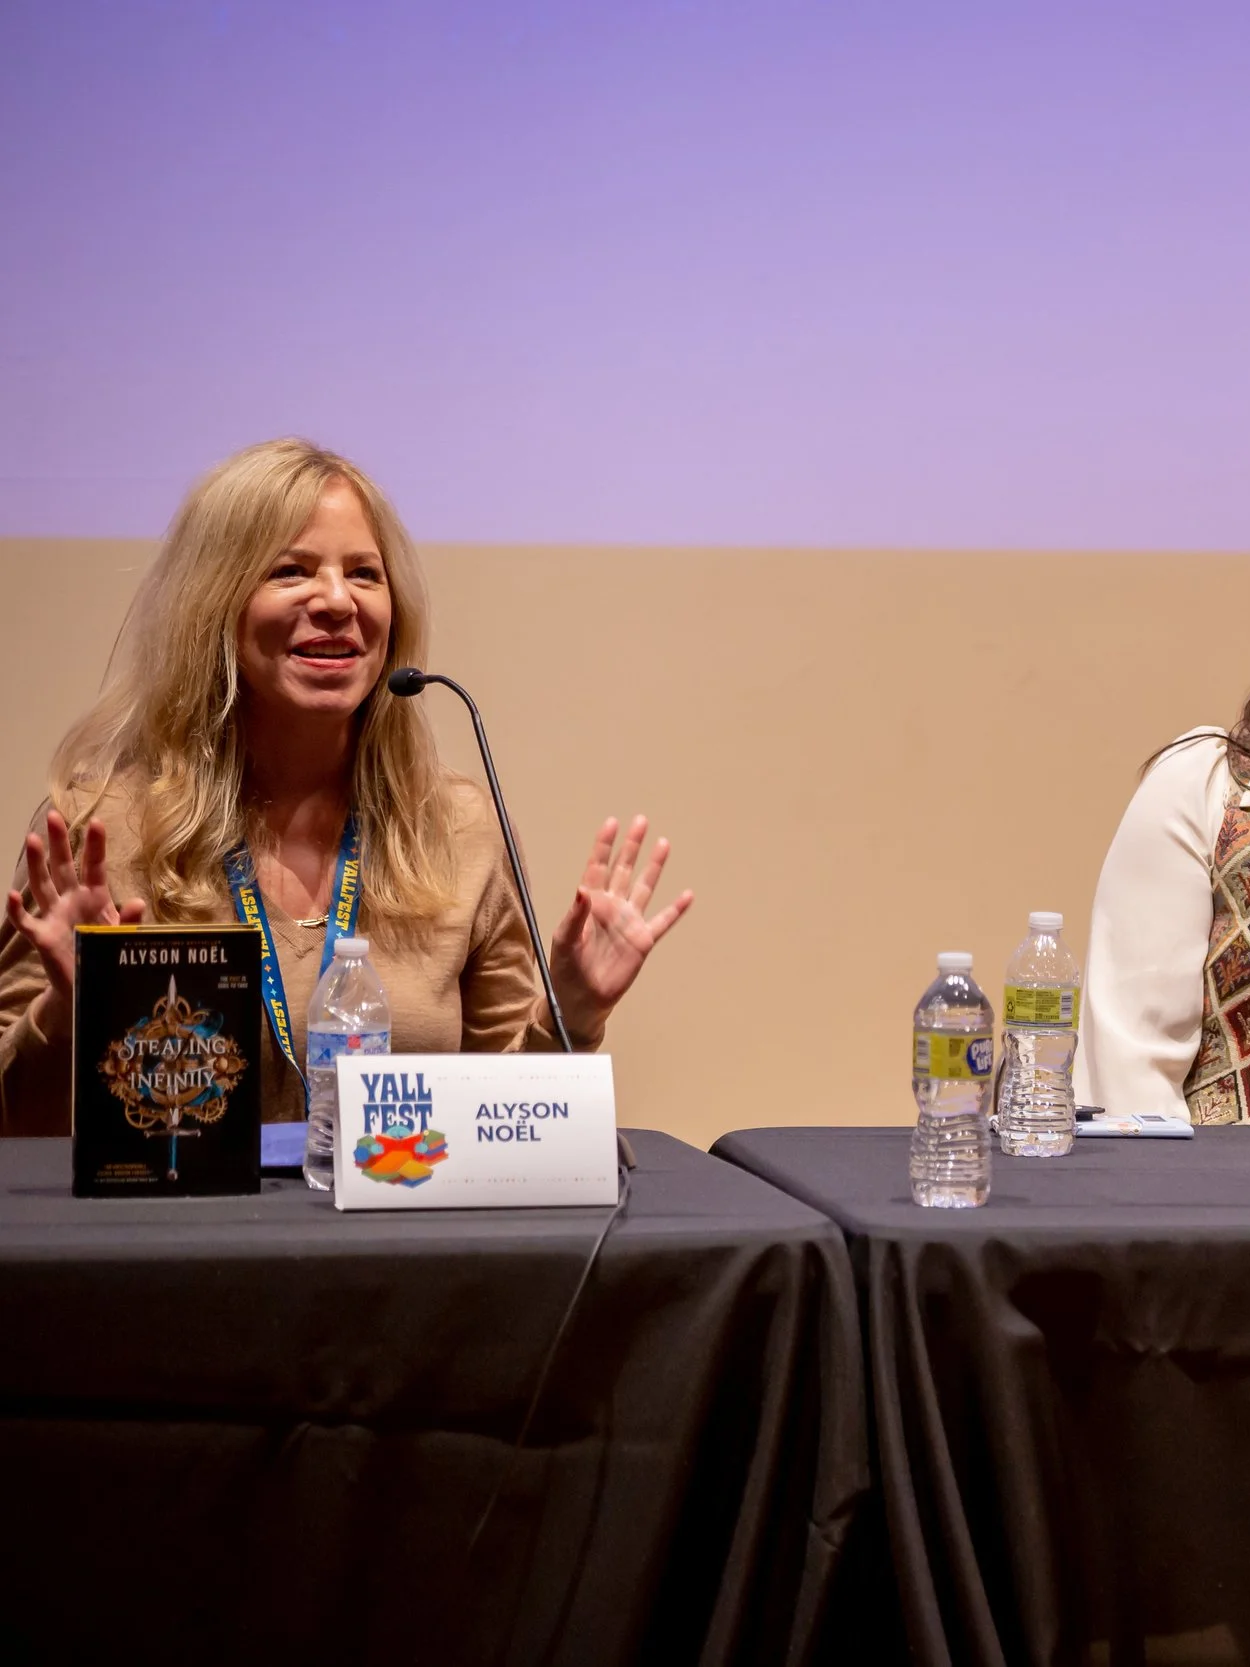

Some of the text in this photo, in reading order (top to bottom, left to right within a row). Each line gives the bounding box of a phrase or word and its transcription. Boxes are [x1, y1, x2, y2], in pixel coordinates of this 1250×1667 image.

[335, 860, 359, 931] YALLFEST
[119, 945, 228, 965] ALYSON NOËL
[118, 1035, 226, 1061] STEALING
[130, 1067, 217, 1090] INFINITY
[360, 1073, 432, 1102] YALL
[362, 1103, 433, 1134] FEST
[475, 1102, 569, 1121] ALYSON
[477, 1120, 542, 1142] NOËL
